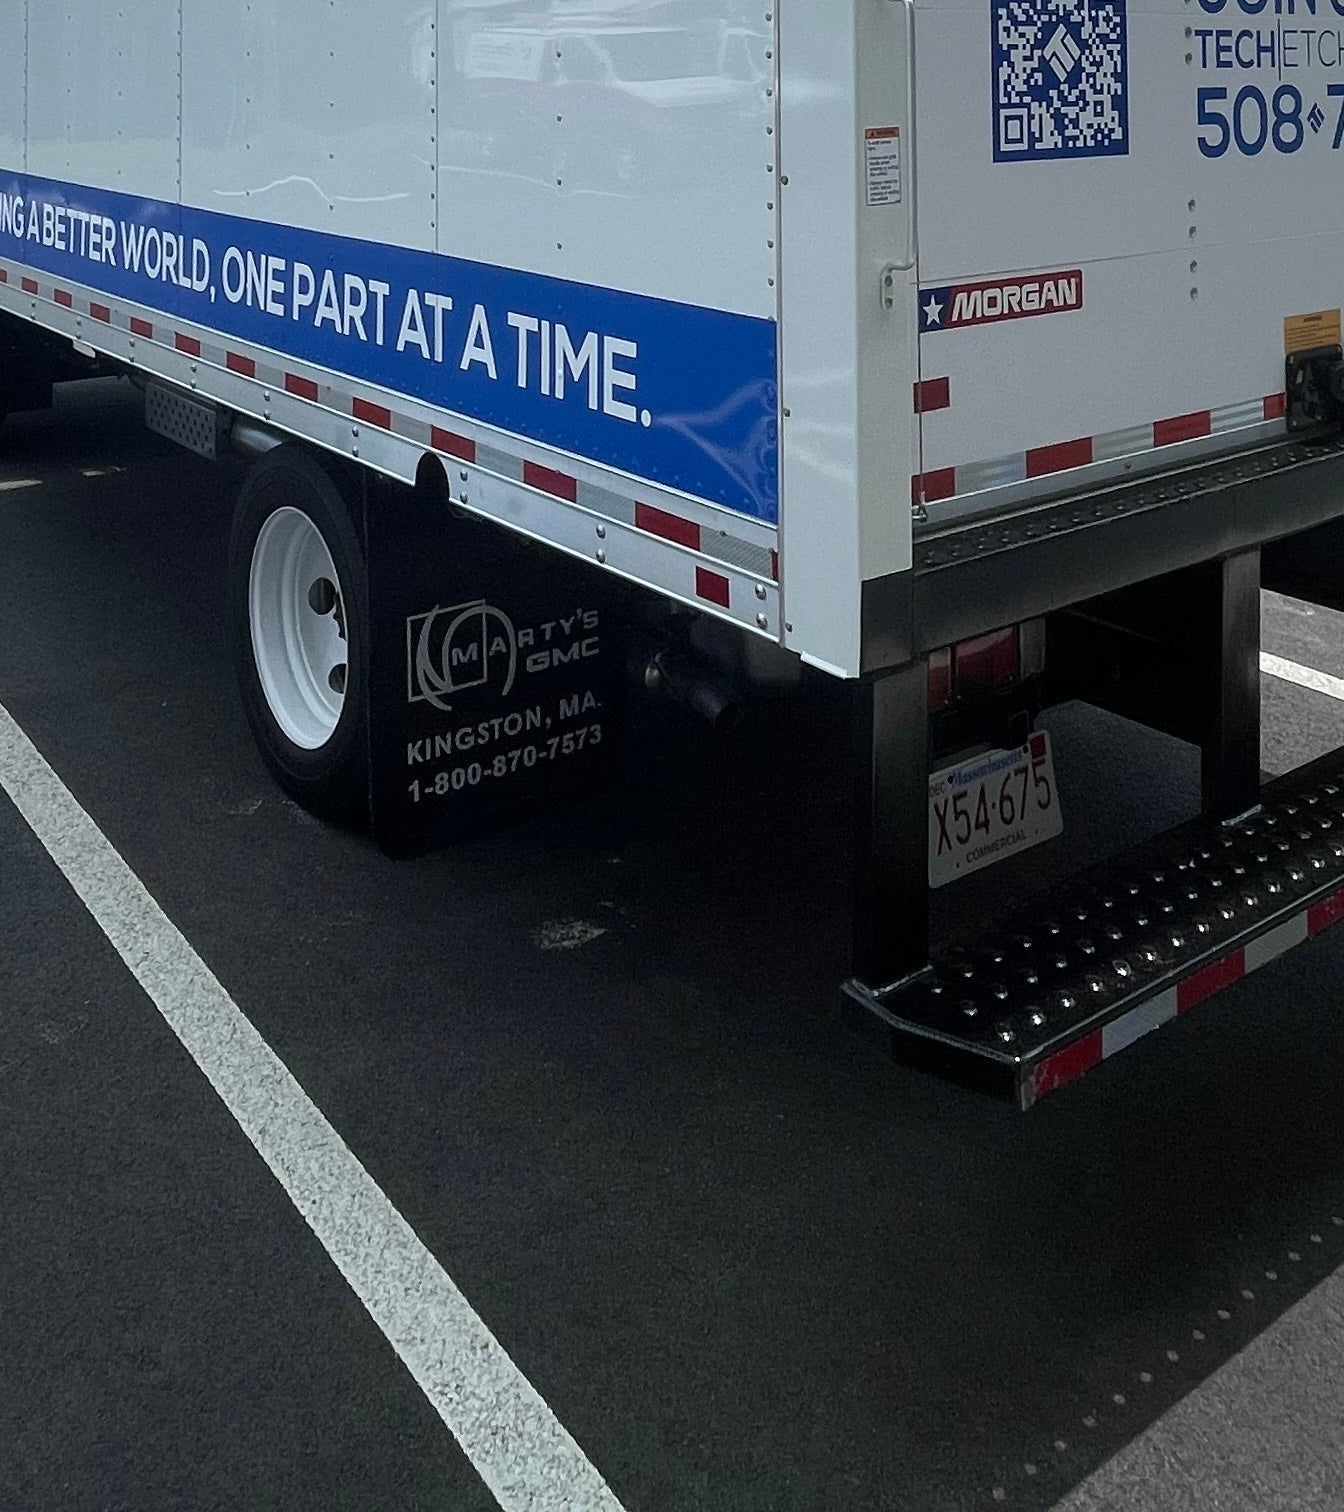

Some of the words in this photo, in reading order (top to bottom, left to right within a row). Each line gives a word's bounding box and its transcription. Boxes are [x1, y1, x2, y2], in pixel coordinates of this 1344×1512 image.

[26, 199, 41, 243] A
[42, 202, 117, 267] BETTER
[120, 220, 216, 304] WORLD,
[221, 245, 286, 317] ONE
[292, 261, 390, 346] PART
[395, 288, 453, 363] AT
[459, 303, 498, 380] A
[506, 311, 652, 428] TIME.
[951, 277, 1077, 322] MORGAN
[451, 608, 599, 666] MARTY'S
[526, 636, 600, 673] GMC
[407, 705, 552, 765] KINGSTON,
[559, 689, 602, 720] MA.
[408, 724, 602, 803] 1-800-870-7573
[965, 829, 1027, 863] COMMERCIAL
